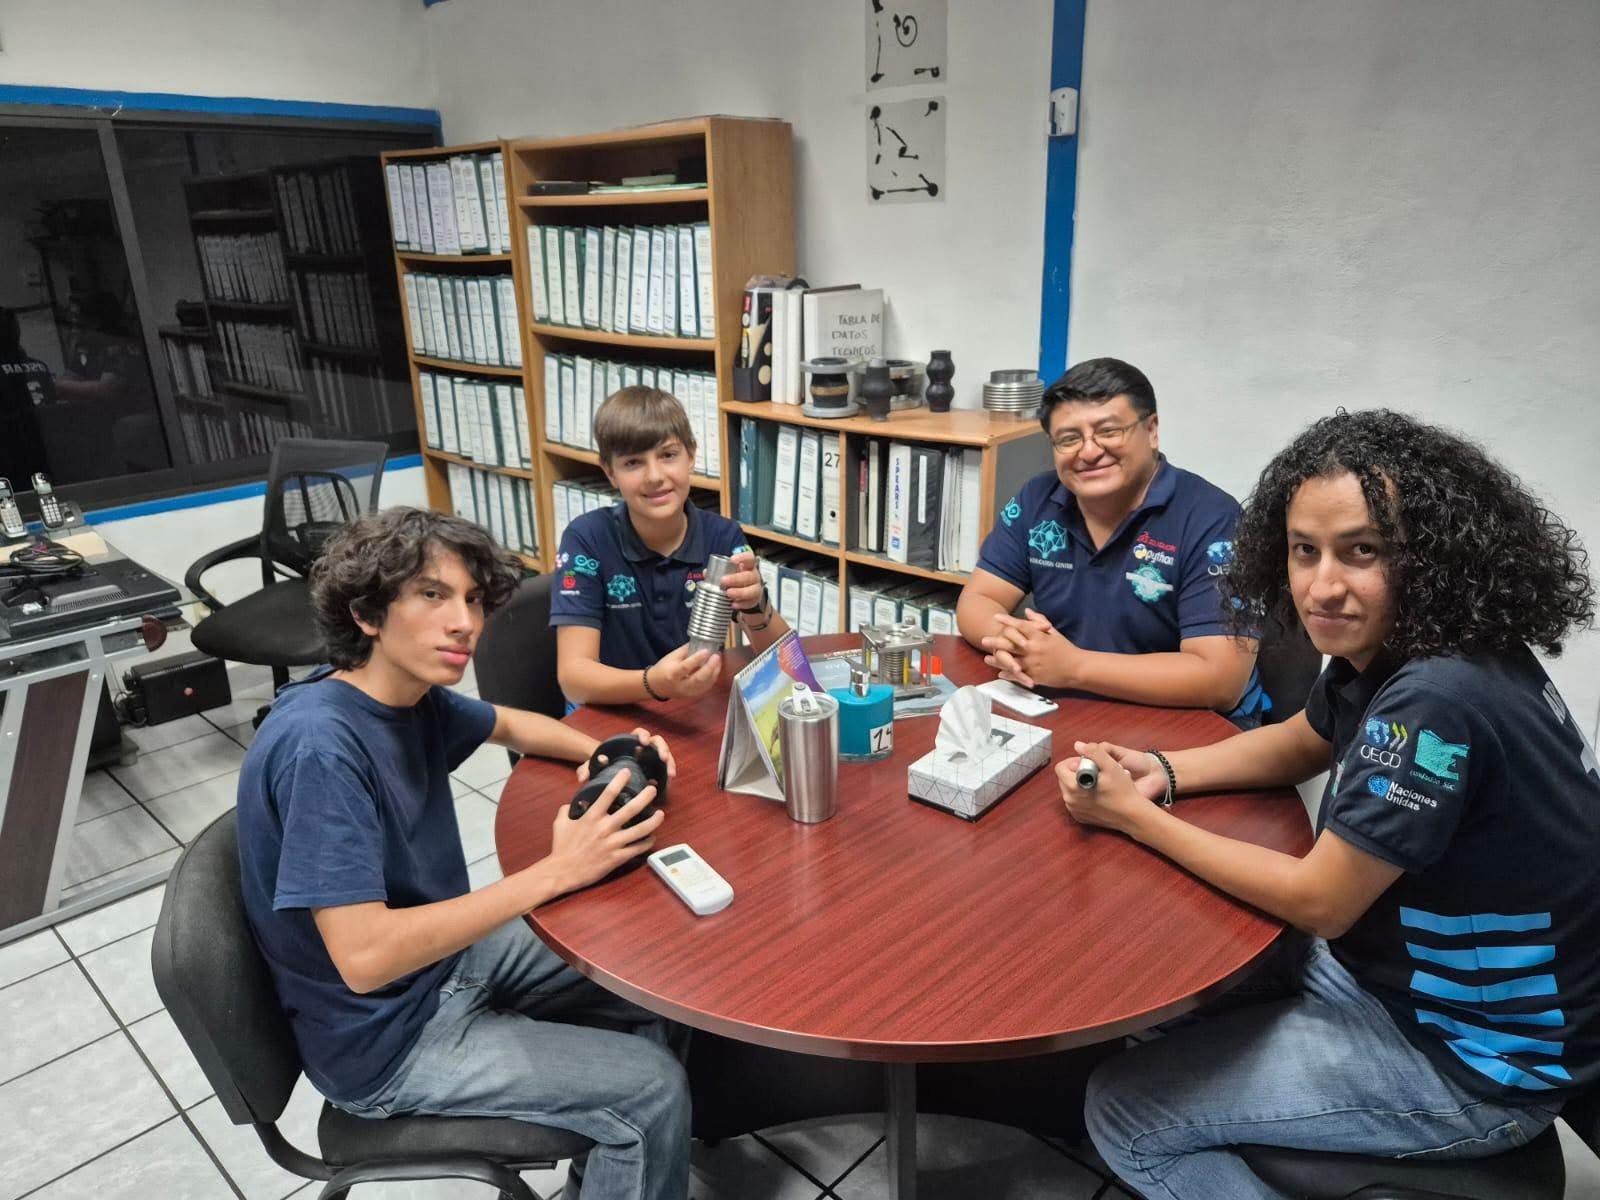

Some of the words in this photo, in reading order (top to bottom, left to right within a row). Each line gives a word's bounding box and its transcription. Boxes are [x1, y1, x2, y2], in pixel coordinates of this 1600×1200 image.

[832, 330, 868, 340] DATOS
[824, 452, 841, 468] 27
[1360, 745, 1401, 768] OECD
[1385, 791, 1421, 811] Unidas
[1388, 780, 1438, 808] Naciones
